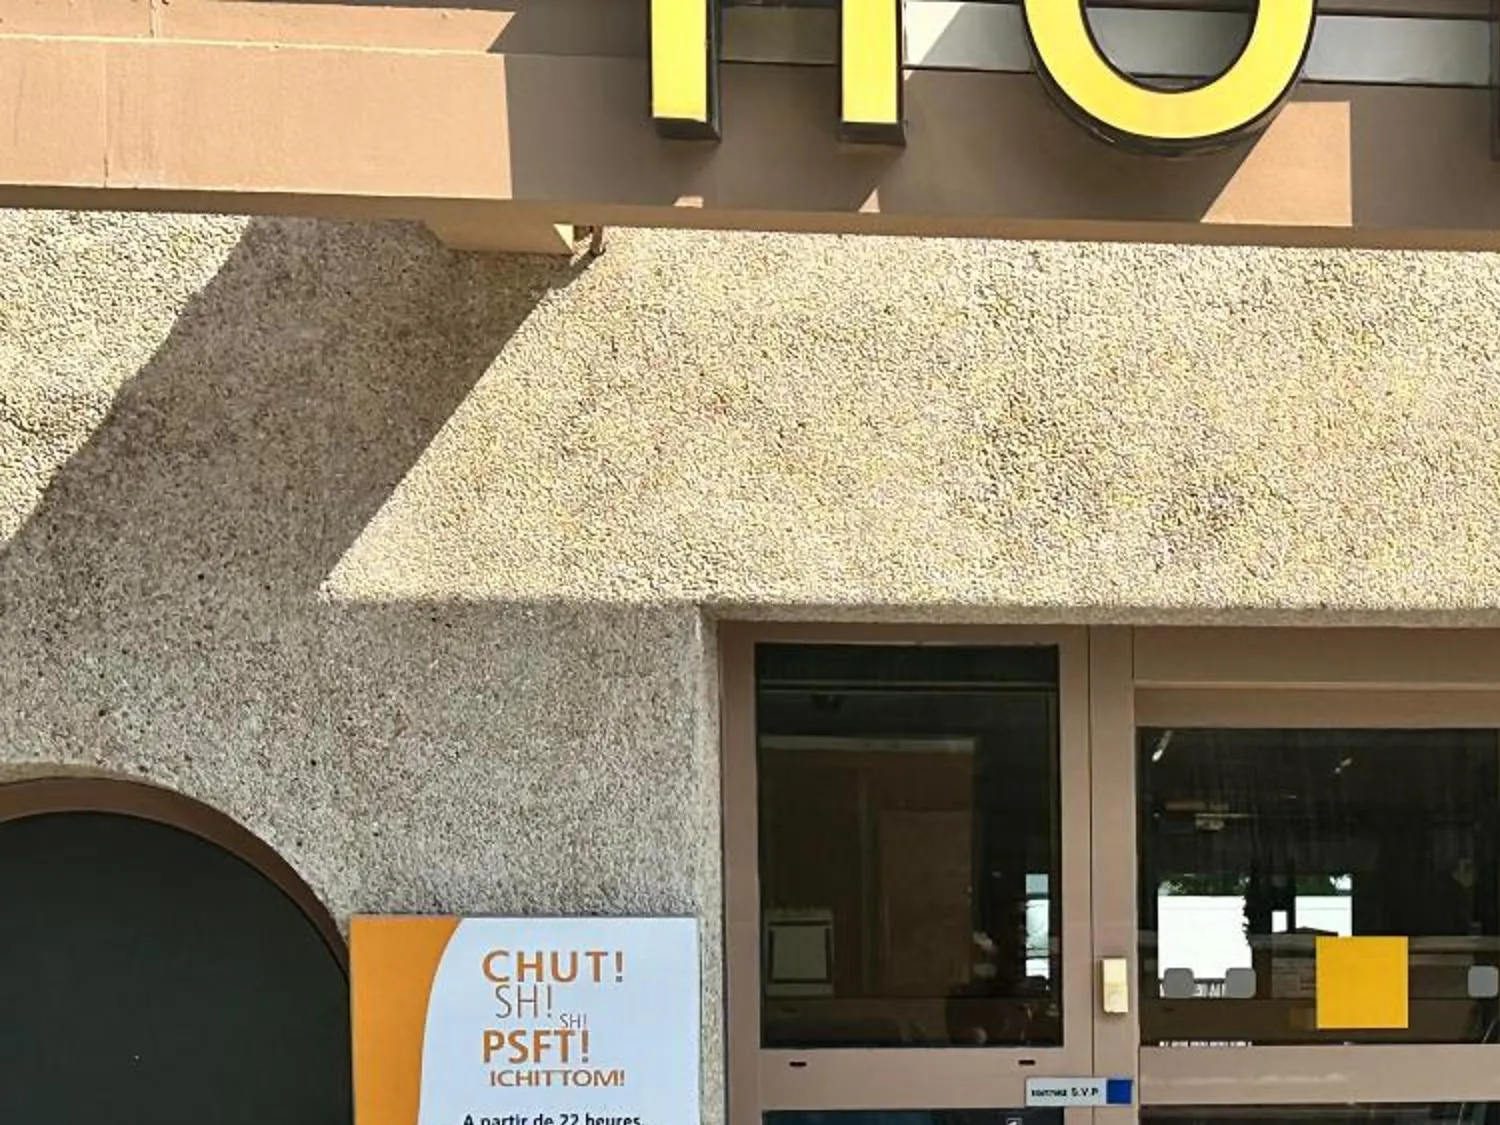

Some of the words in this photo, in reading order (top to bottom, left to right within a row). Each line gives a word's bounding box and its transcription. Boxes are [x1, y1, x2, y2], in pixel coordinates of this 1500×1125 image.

[482, 949, 623, 983] CHUT!
[495, 984, 552, 1019] SH!
[559, 1013, 588, 1029] SH!
[483, 1029, 590, 1064] PSFT!
